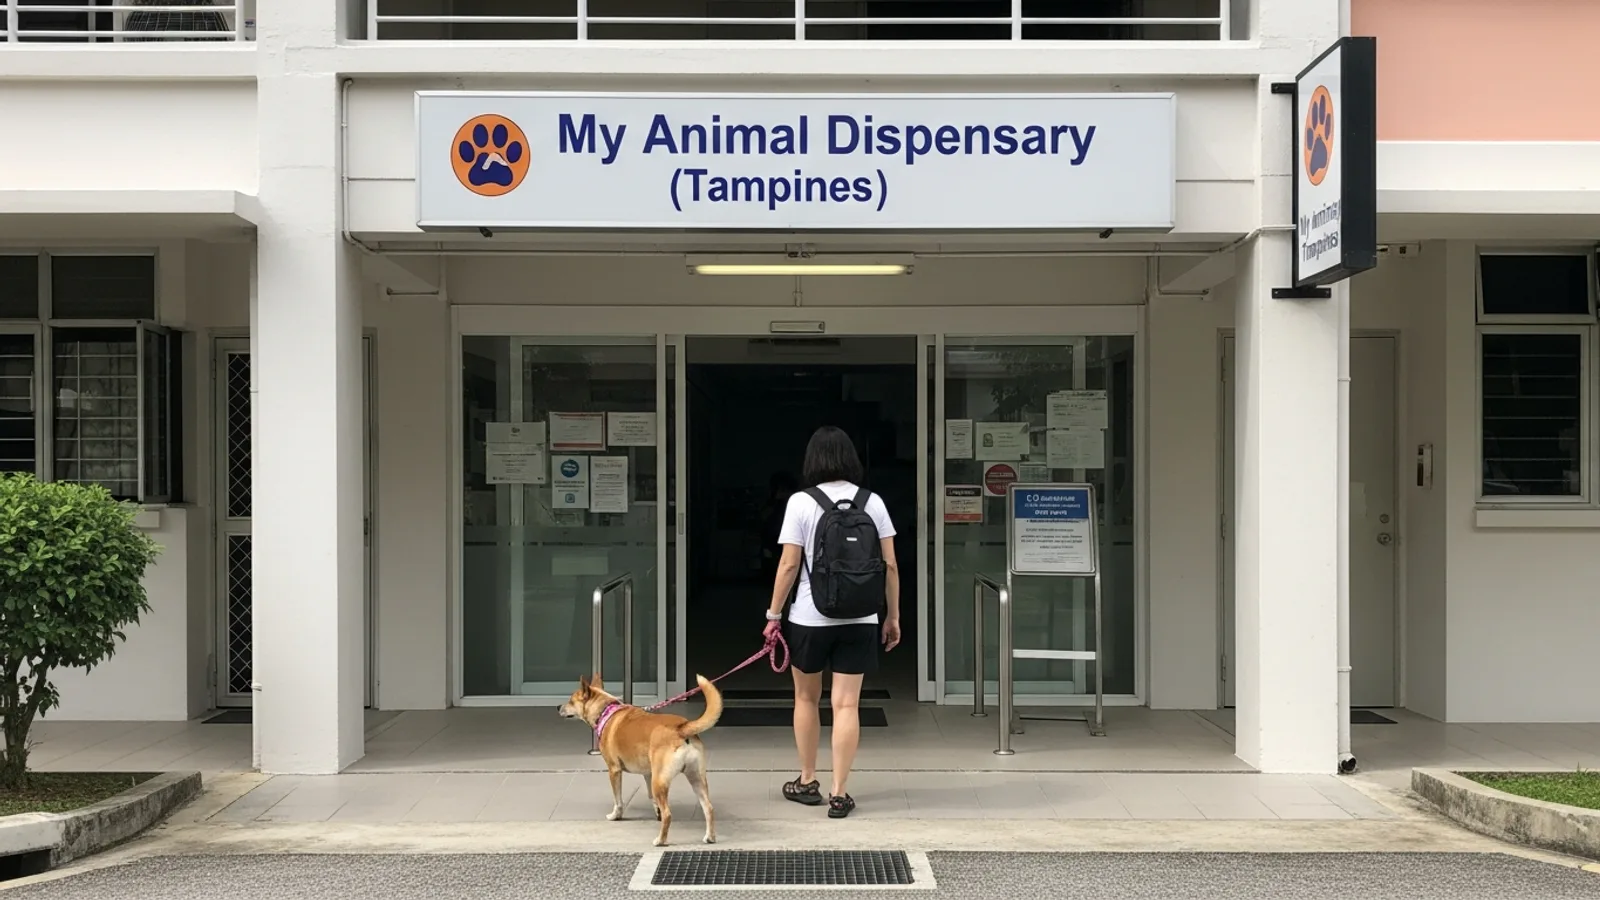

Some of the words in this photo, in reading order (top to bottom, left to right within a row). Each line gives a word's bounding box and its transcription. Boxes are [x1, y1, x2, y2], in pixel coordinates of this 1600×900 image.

[558, 113, 627, 165] My
[642, 113, 808, 155] Animal
[827, 113, 1097, 166] Dispensary
[670, 167, 888, 212] (Tampines)
